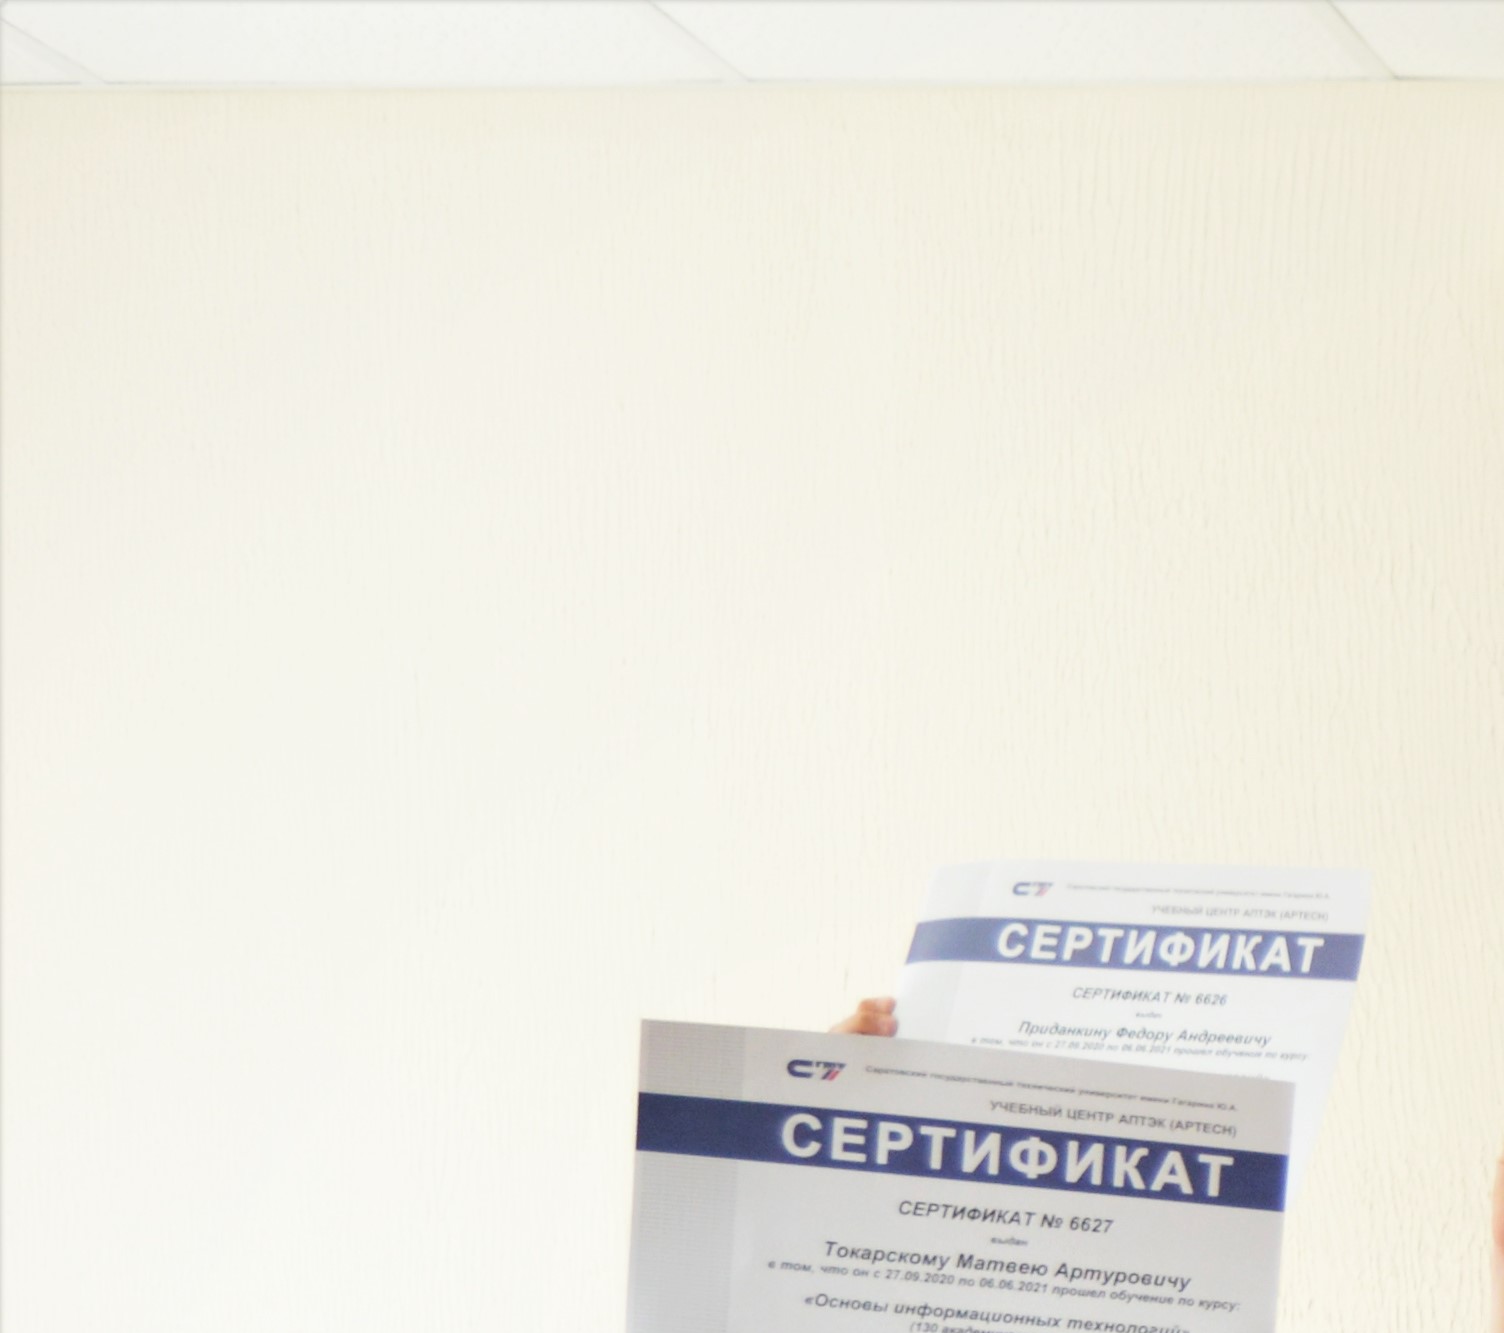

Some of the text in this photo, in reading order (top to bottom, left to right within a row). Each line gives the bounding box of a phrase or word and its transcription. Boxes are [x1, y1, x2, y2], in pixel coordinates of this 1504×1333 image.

[997, 922, 1325, 974] СЕРТИФИКАТ
[780, 1112, 1235, 1199] СЕРТИФИКАТ
[899, 1200, 1036, 1226] СЕРТИФИКАТ
[1069, 1216, 1114, 1233] 6627
[825, 1241, 1191, 1292] Токарскому Матвею Артуровичу
[893, 1303, 1062, 1327] информационных
